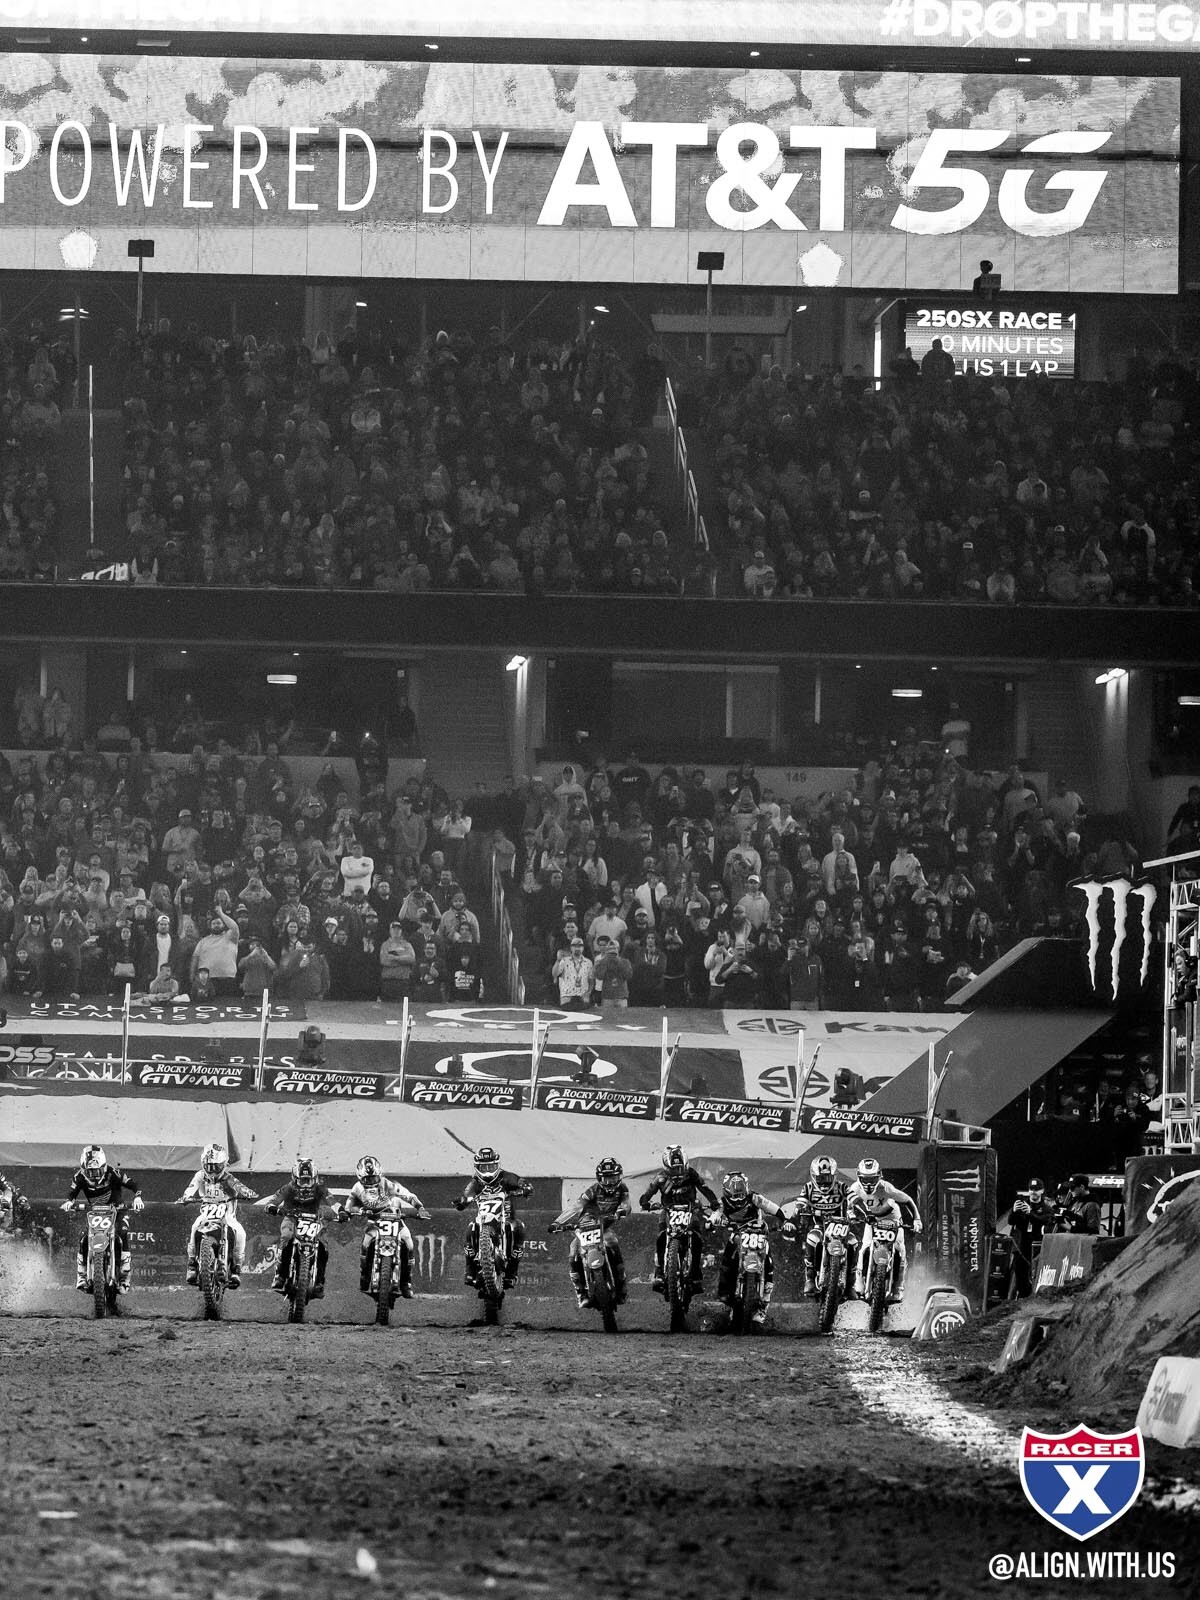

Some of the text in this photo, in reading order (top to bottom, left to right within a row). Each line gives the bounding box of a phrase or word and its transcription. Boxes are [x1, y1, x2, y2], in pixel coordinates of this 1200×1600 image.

[422, 130, 509, 215] BY
[537, 120, 876, 232] AT&T
[890, 129, 1113, 237] 5G
[916, 310, 1076, 330] 250SX RACE 1
[961, 336, 1063, 354] MINUTES
[1000, 359, 1008, 376] 1
[1016, 360, 1059, 377] LAP
[30, 1003, 125, 1011] UTAH
[30, 1010, 287, 1021] COMMISSION
[156, 1064, 242, 1075] ROCKY MOUNTAIN
[291, 1072, 376, 1084] ROCKY MOUNTAIN
[429, 1082, 514, 1094] ROCKY MOUNTAIN
[563, 1089, 648, 1103] ROCKY MOUNTAIN
[697, 1101, 782, 1116] ROCKY MOUNTAIN
[828, 1110, 914, 1125] ROCKY MOUNTAIN
[480, 1201, 502, 1213] 57
[91, 1216, 111, 1228] 96
[297, 1220, 320, 1236] 58
[379, 1221, 398, 1236] 31
[824, 1223, 849, 1236] 460
[873, 1230, 895, 1241] 330
[741, 1233, 766, 1248] 285
[970, 1218, 979, 1272] MONSTER
